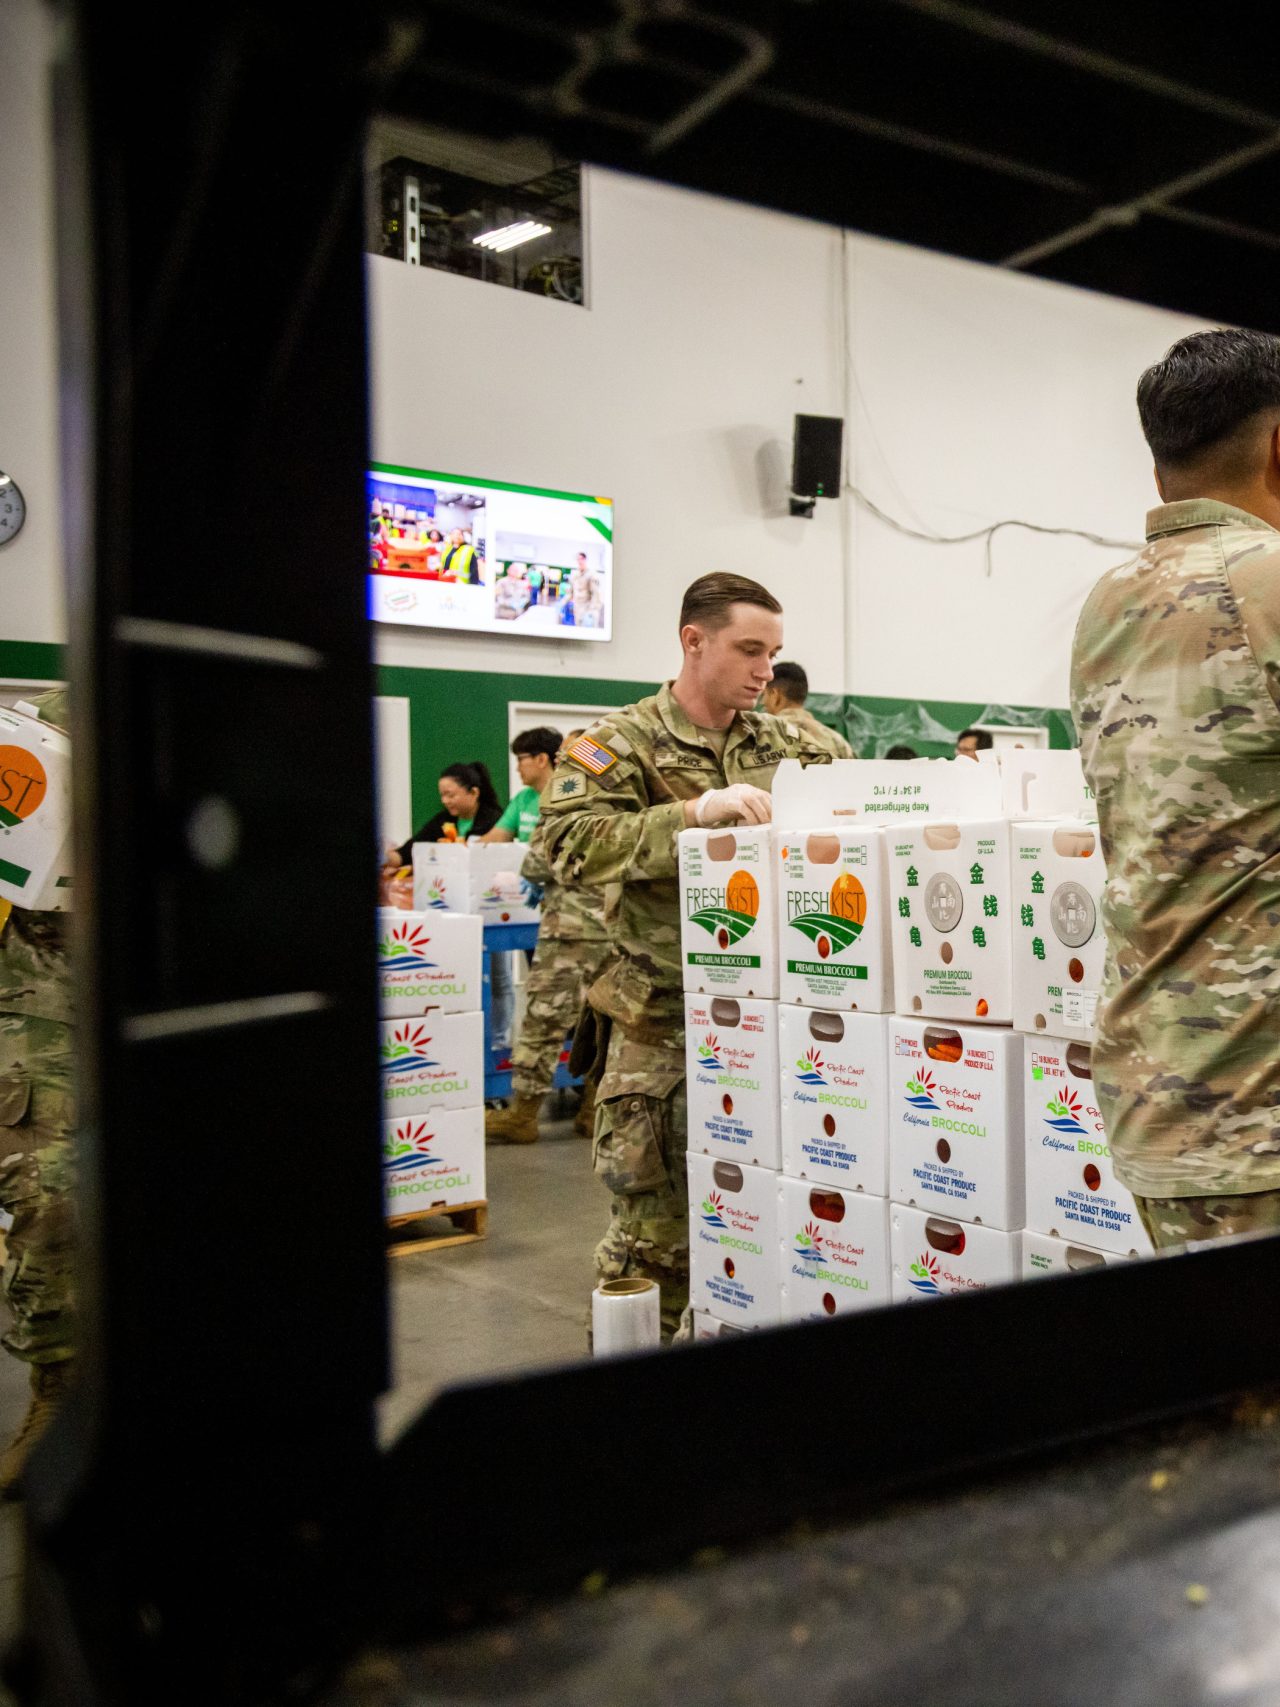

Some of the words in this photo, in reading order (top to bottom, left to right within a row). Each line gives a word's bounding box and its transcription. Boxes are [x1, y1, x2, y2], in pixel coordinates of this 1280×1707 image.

[864, 801, 910, 813] Refrigerated
[912, 802, 930, 813] Keep
[694, 954, 720, 965] PREMIUM
[721, 956, 751, 966] BROCCOLI
[795, 962, 822, 974] PREMIUM
[823, 965, 857, 977] BROCCOLI
[923, 969, 947, 979] PREMIUM
[947, 970, 972, 980] BROCCOLI
[382, 983, 466, 998] BROCCOLI
[847, 1065, 865, 1076] Coast
[383, 1078, 469, 1100] BROCCOLI
[717, 1075, 760, 1090] BROCCOLI
[818, 1092, 867, 1110] BROCCOLI
[939, 1085, 961, 1098] Pacific
[962, 1089, 982, 1101] Coast
[946, 1100, 974, 1112] Produce
[903, 1111, 930, 1126] California
[931, 1116, 986, 1137] BROCCOLI
[801, 1144, 819, 1156] PACIFIC
[819, 1147, 834, 1159] COAST
[835, 1151, 857, 1163] PRODUCE
[1042, 1135, 1075, 1152] California
[1077, 1139, 1112, 1158] BROC
[387, 1173, 471, 1198] BROCCOLI
[912, 1168, 932, 1181] PACIFIC
[933, 1173, 950, 1186] COAST
[950, 1178, 976, 1192] PRODUCE
[921, 1181, 933, 1191] SANTA
[1067, 1190, 1084, 1201] PACKED
[1090, 1195, 1109, 1207] SHIPPED
[1055, 1196, 1078, 1211] PACIFIC
[1079, 1202, 1099, 1216] COAST
[1101, 1208, 1132, 1224] PRODUCE
[1064, 1211, 1080, 1221] SANTA
[1080, 1214, 1096, 1226] MARIA,
[1097, 1219, 1104, 1227] CA
[1105, 1221, 1121, 1232] 93458
[719, 1234, 763, 1256] BROCCOLI
[816, 1268, 869, 1291] BROCCOLI
[943, 1272, 965, 1286] Pacific
